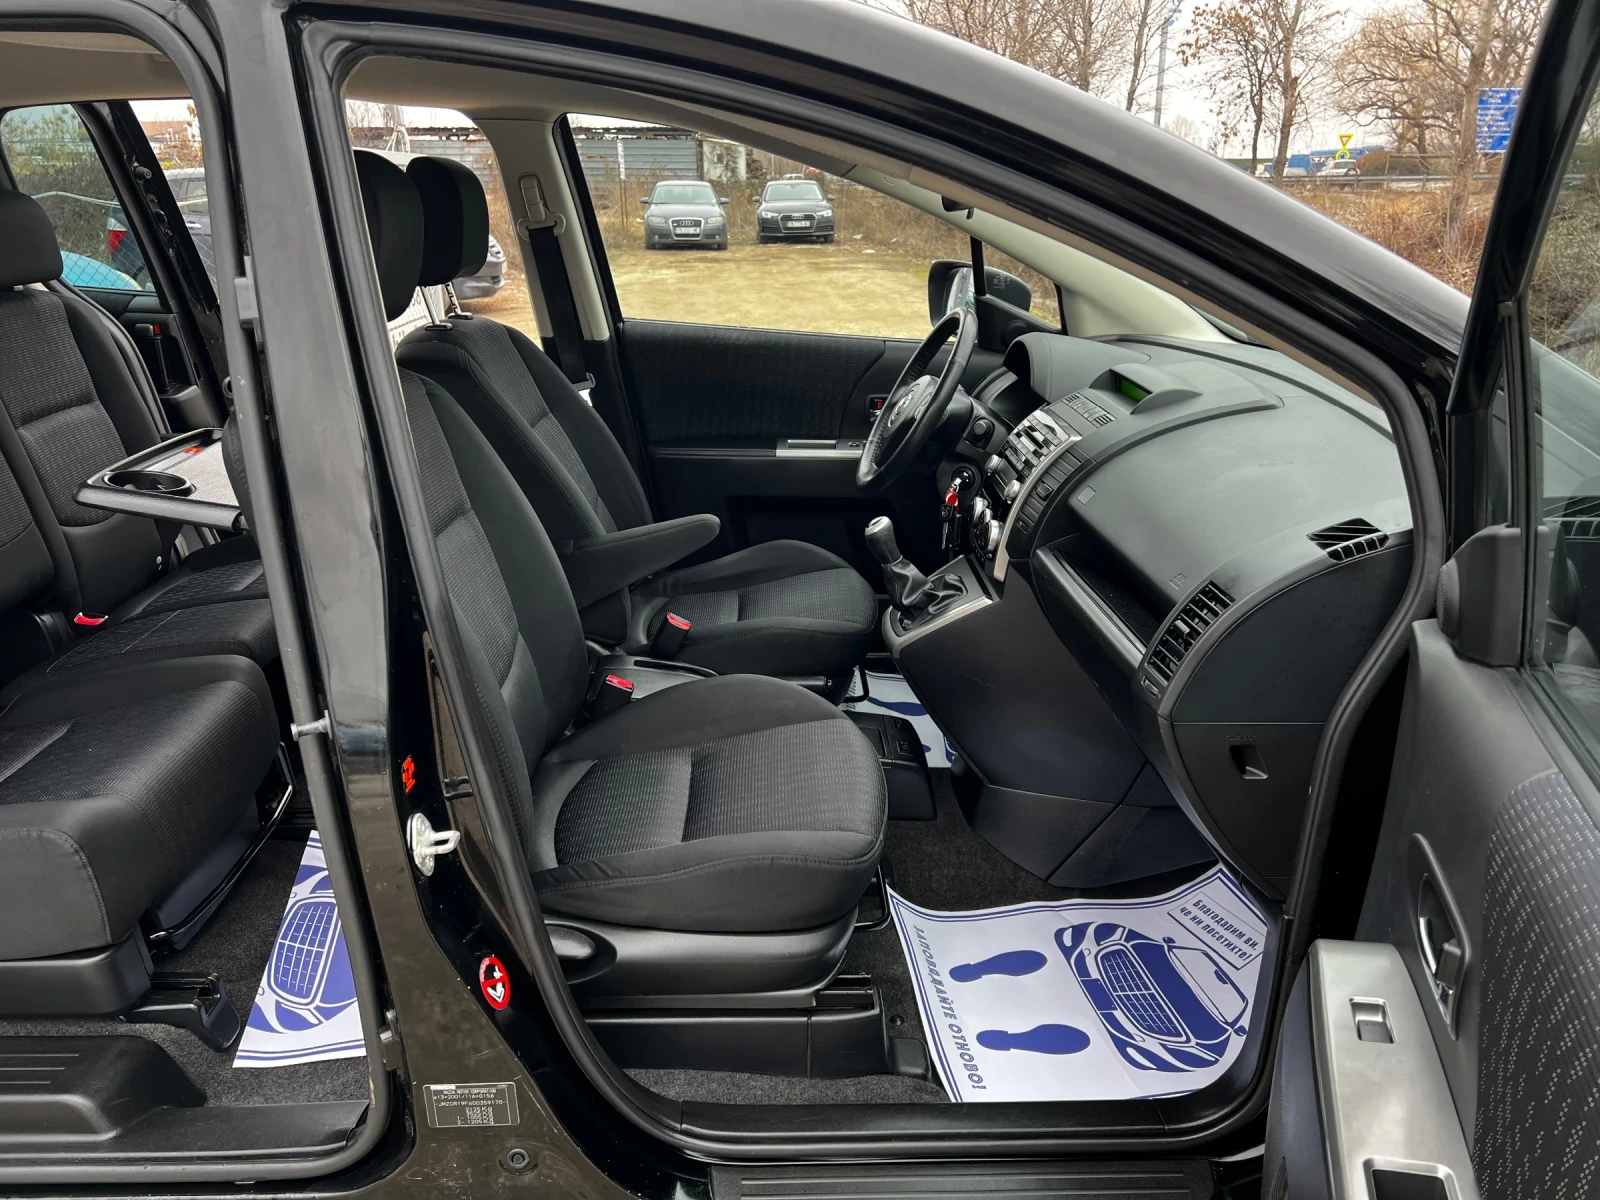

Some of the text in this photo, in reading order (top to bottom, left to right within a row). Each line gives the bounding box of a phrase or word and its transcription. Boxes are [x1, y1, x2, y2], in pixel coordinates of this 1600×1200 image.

[1180, 906, 1253, 961] че ни посетихте!
[1192, 900, 1246, 940] Благодарим
[913, 925, 987, 1090] ЗАПОВЯДАЙТЕ ОТНОВО!
